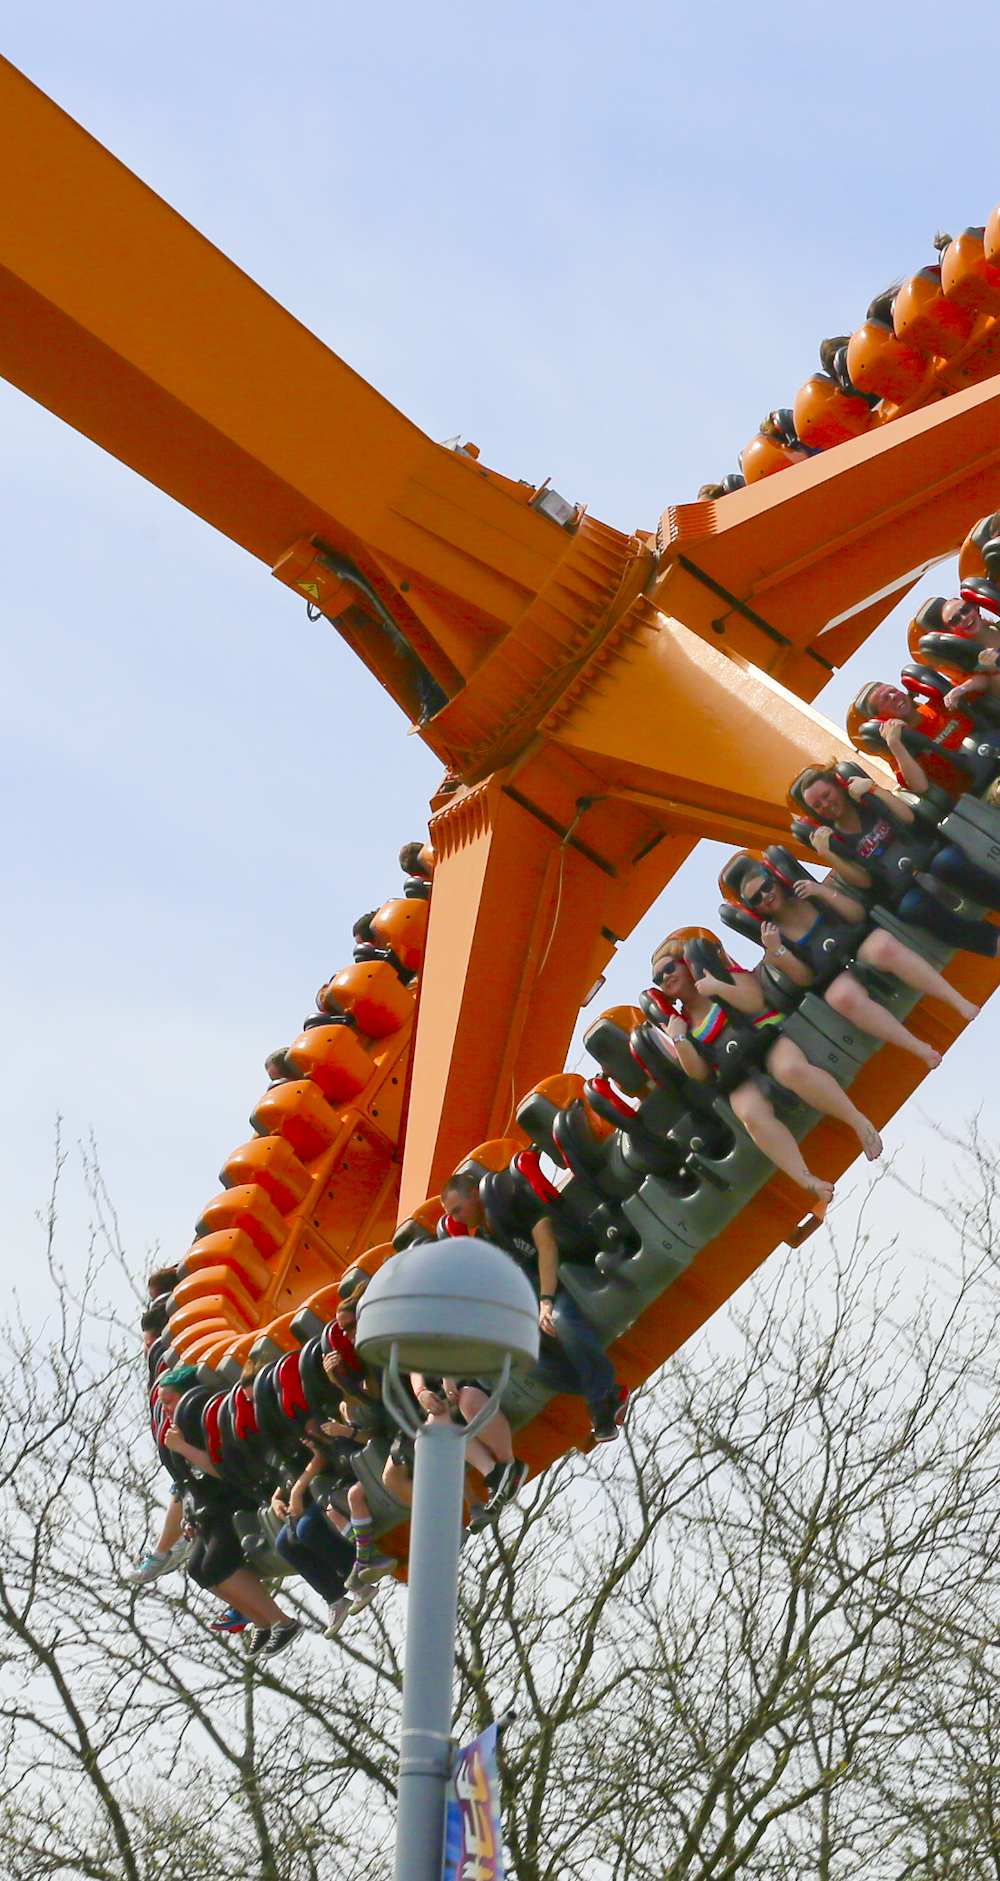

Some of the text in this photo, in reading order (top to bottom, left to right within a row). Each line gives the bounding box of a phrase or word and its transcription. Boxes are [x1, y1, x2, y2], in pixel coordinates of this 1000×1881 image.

[842, 1035, 853, 1046] 9
[828, 1053, 839, 1063] 8
[677, 1220, 688, 1232] 7
[662, 1240, 673, 1250] 6
